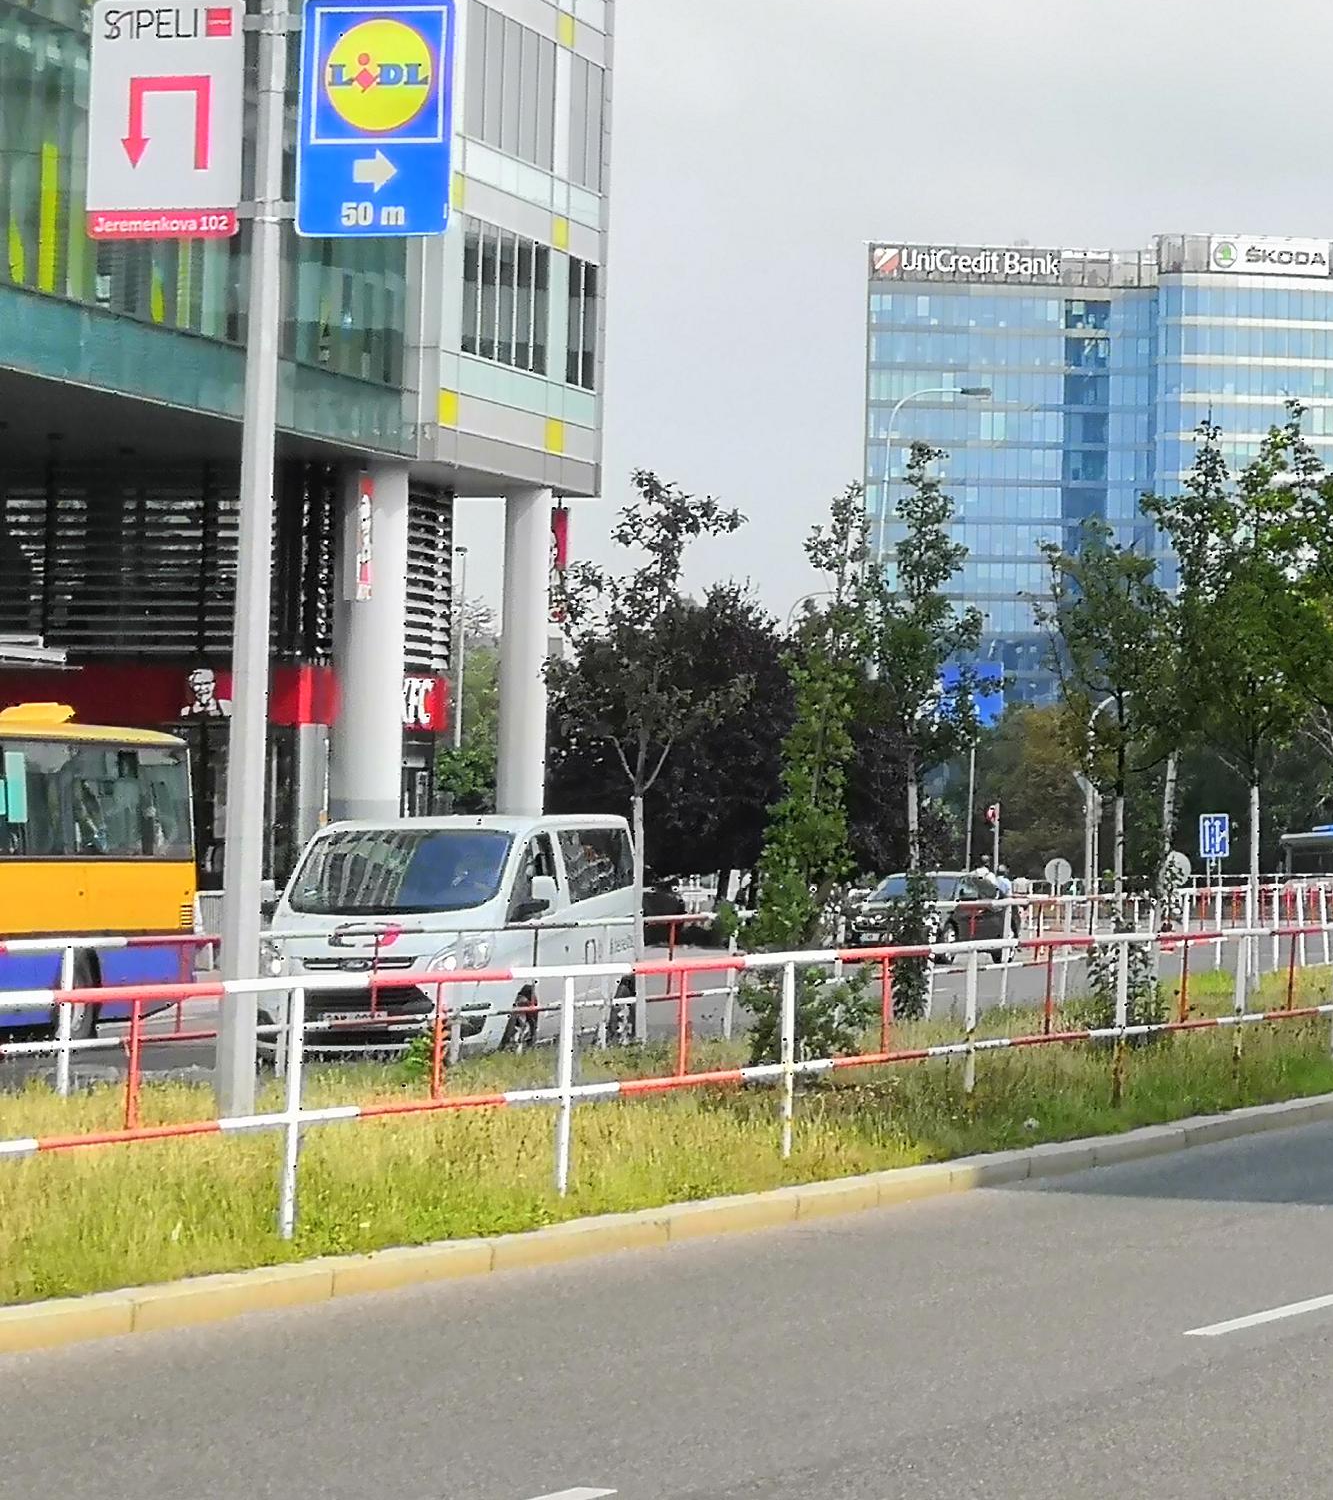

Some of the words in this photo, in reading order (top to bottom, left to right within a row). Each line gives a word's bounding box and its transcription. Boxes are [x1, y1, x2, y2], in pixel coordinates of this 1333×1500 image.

[94, 217, 197, 233] Jeremenkova
[200, 215, 228, 231] 102
[341, 201, 373, 227] 50
[381, 204, 405, 227] m
[901, 248, 999, 274] UniCredit
[1004, 251, 1060, 276] Bank
[1245, 244, 1326, 266] ŠKODA
